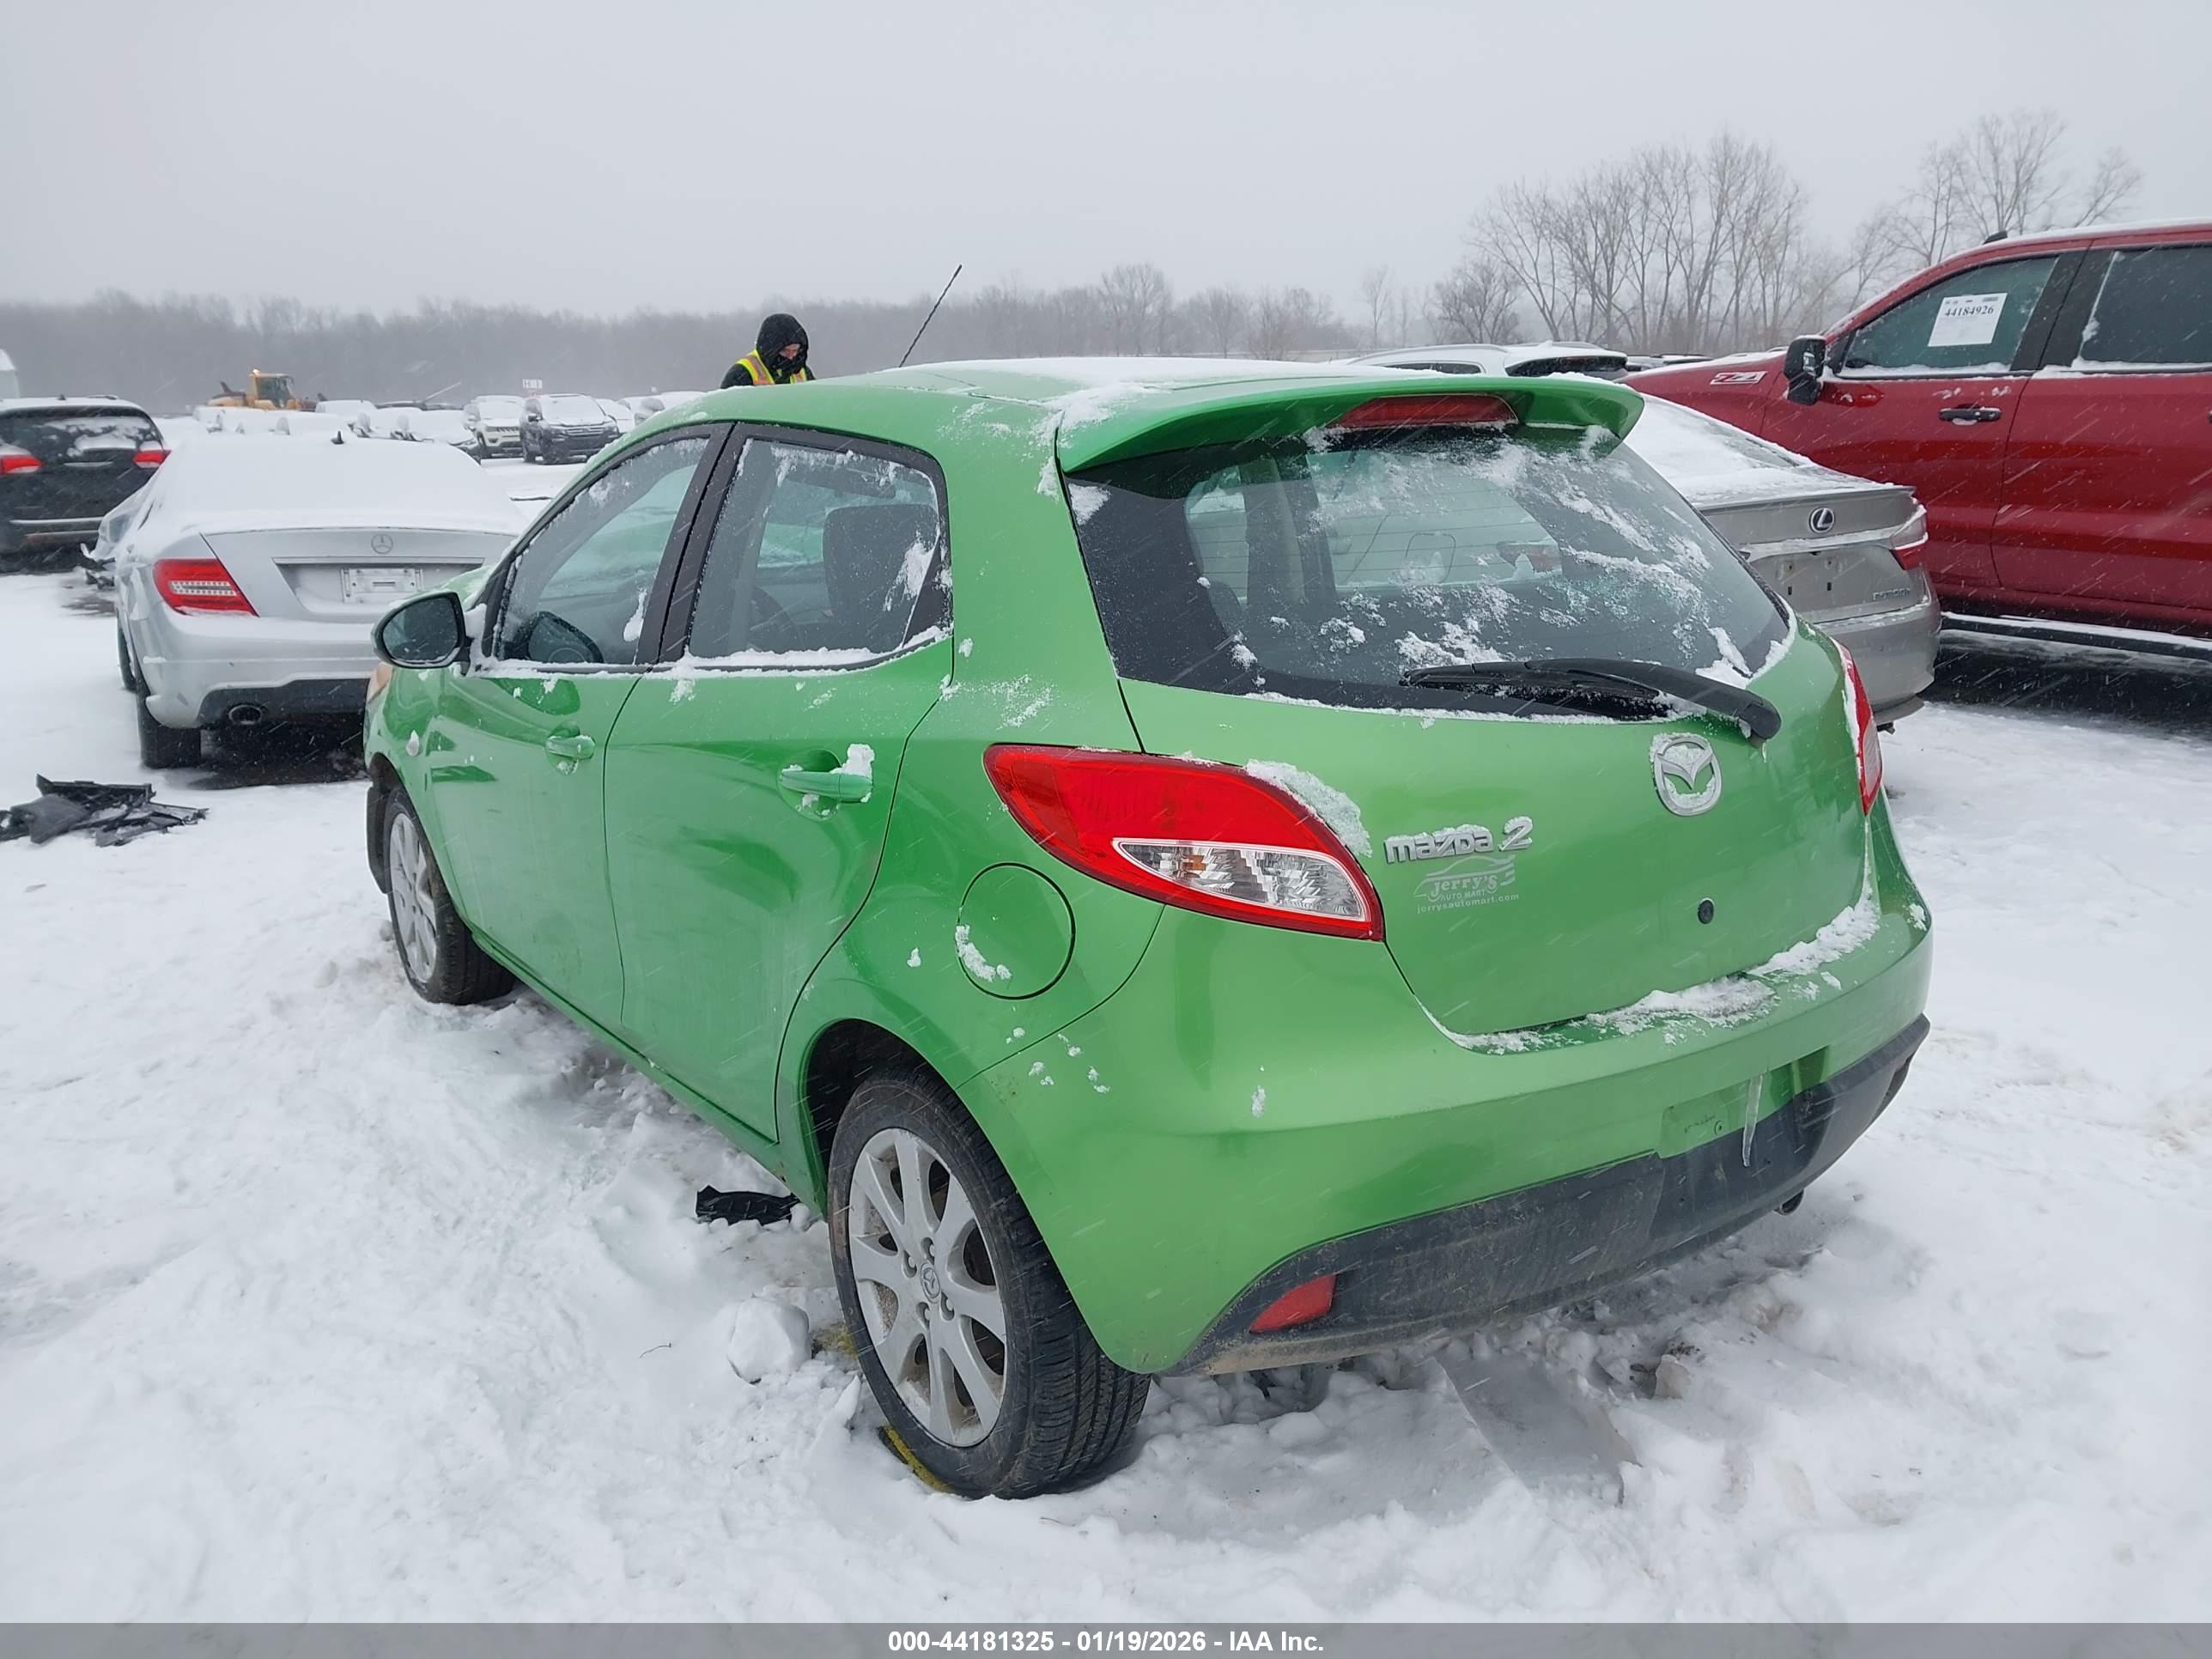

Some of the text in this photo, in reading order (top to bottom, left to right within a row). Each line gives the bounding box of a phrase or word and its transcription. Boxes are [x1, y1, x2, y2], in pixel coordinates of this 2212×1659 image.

[1944, 305, 1994, 317] 44184926
[1498, 816, 1534, 852] 2
[1417, 893, 1519, 915] jerrysautomart.com
[1440, 889, 1486, 902] AUTO MART
